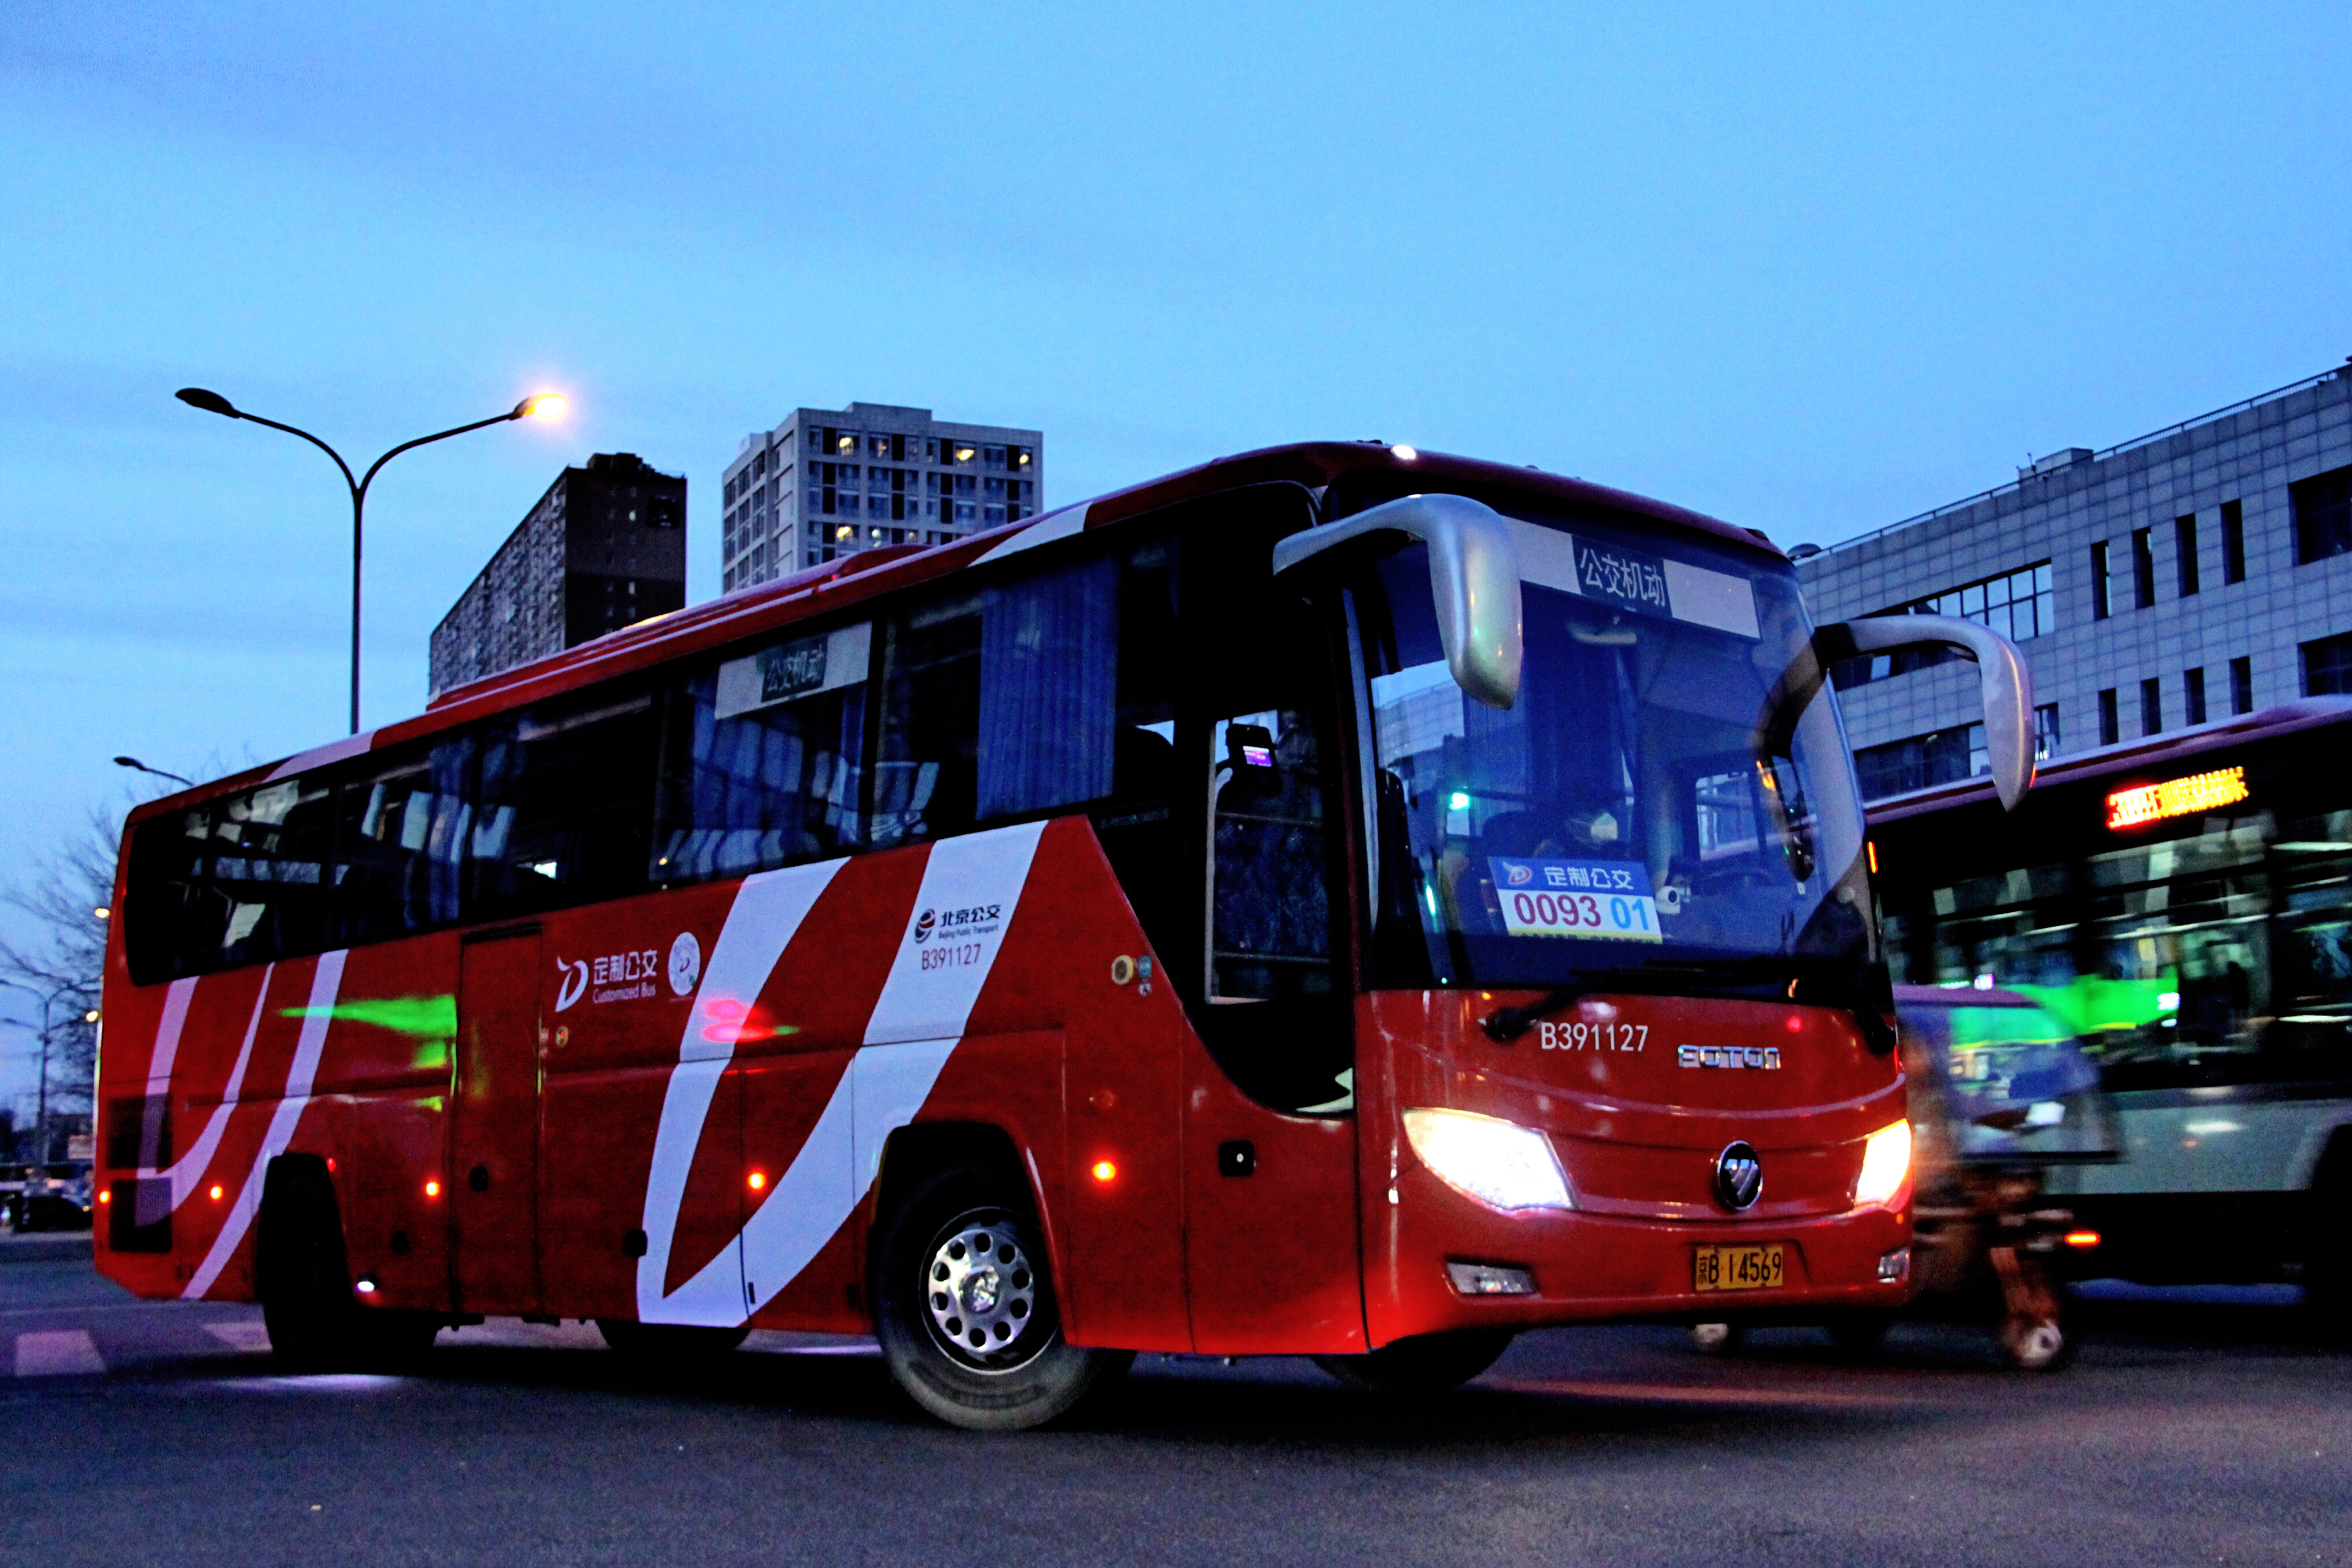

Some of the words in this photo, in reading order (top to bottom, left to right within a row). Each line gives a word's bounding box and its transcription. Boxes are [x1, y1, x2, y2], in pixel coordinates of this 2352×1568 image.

[1581, 548, 1665, 607] 公交机动
[1544, 866, 1634, 889] 定制公交
[941, 905, 1002, 927] 北京公交
[1514, 892, 1601, 927] 0093
[1610, 897, 1649, 931] 01
[593, 949, 657, 985] 定制公交
[922, 943, 981, 970] B391127
[641, 982, 657, 997] Bus
[1541, 1022, 1648, 1052] B391127
[1677, 1044, 1782, 1070] FOTON
